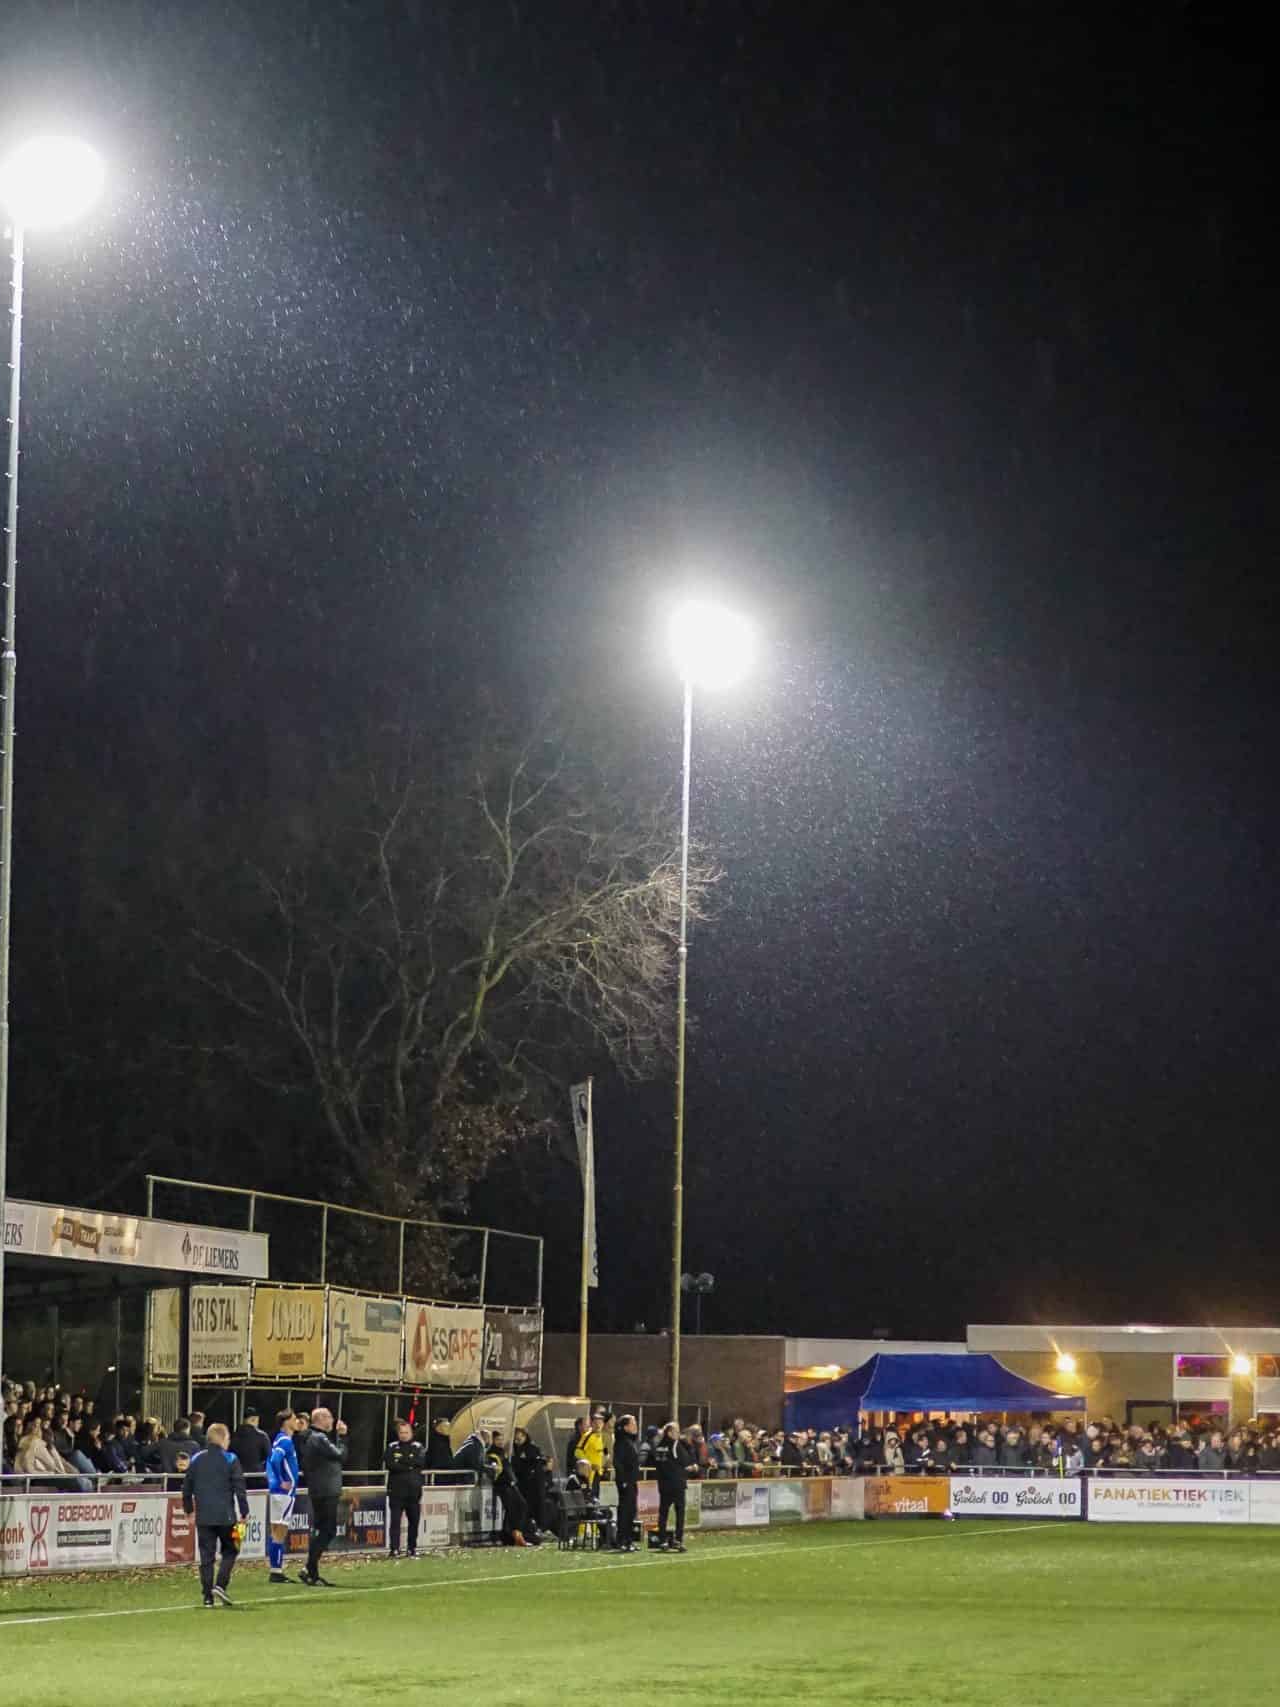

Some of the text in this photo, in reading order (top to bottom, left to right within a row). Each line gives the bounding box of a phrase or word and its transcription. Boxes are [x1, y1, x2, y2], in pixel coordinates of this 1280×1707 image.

[193, 1244, 239, 1271] DE LIEMERS
[267, 1297, 317, 1341] JUMBO
[432, 1327, 478, 1361] ESCAPE
[895, 1496, 928, 1512] vitaal
[952, 1489, 987, 1505] Grolsch
[1015, 1489, 1053, 1506] Grolsch
[57, 1504, 113, 1522] BOERBOOM
